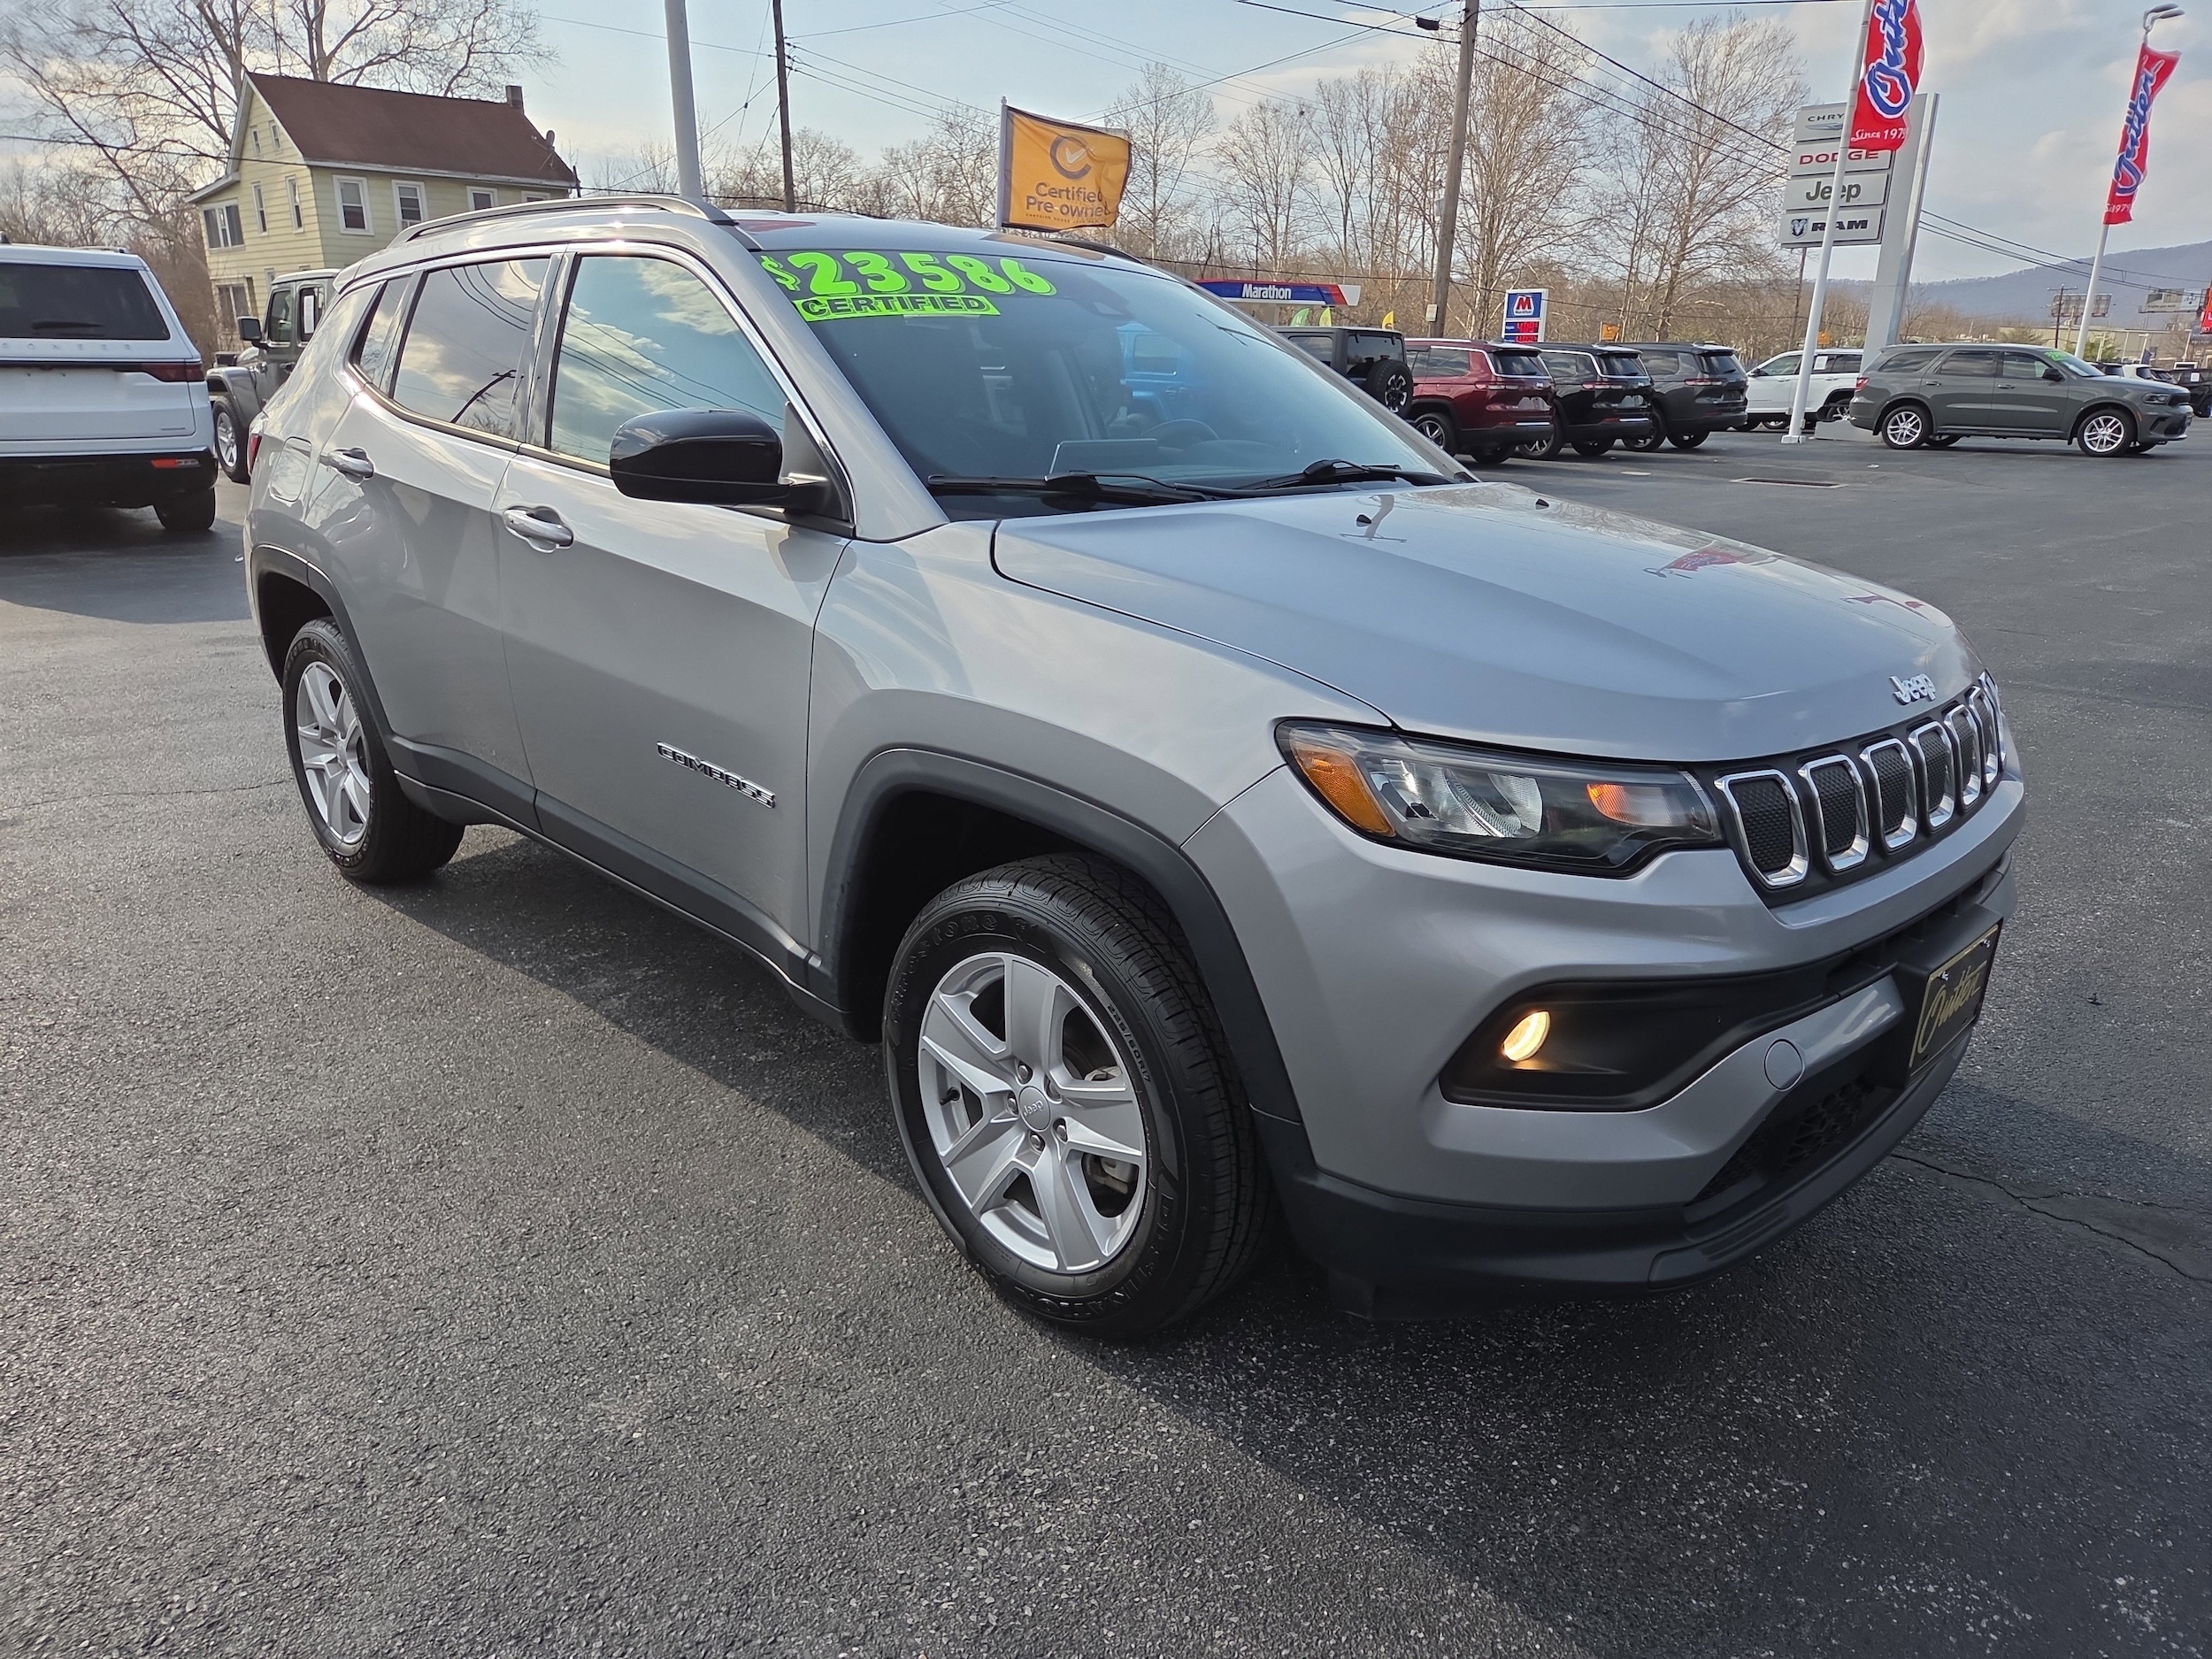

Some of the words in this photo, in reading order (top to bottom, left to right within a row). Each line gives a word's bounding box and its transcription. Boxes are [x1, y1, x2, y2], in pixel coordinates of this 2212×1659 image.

[1808, 113, 1845, 122] CHRY
[1851, 129, 1881, 142] Since
[1035, 182, 1103, 203] Certified
[1806, 181, 1862, 203] Jeep
[1811, 219, 1869, 232] RAM
[760, 251, 1056, 296] $23586
[1242, 283, 1292, 300] Marathon
[801, 296, 992, 317] CERTIFIED
[1889, 673, 1936, 703] Jeep
[657, 741, 776, 809] COMPASS
[1023, 1100, 1044, 1117] Jeep
